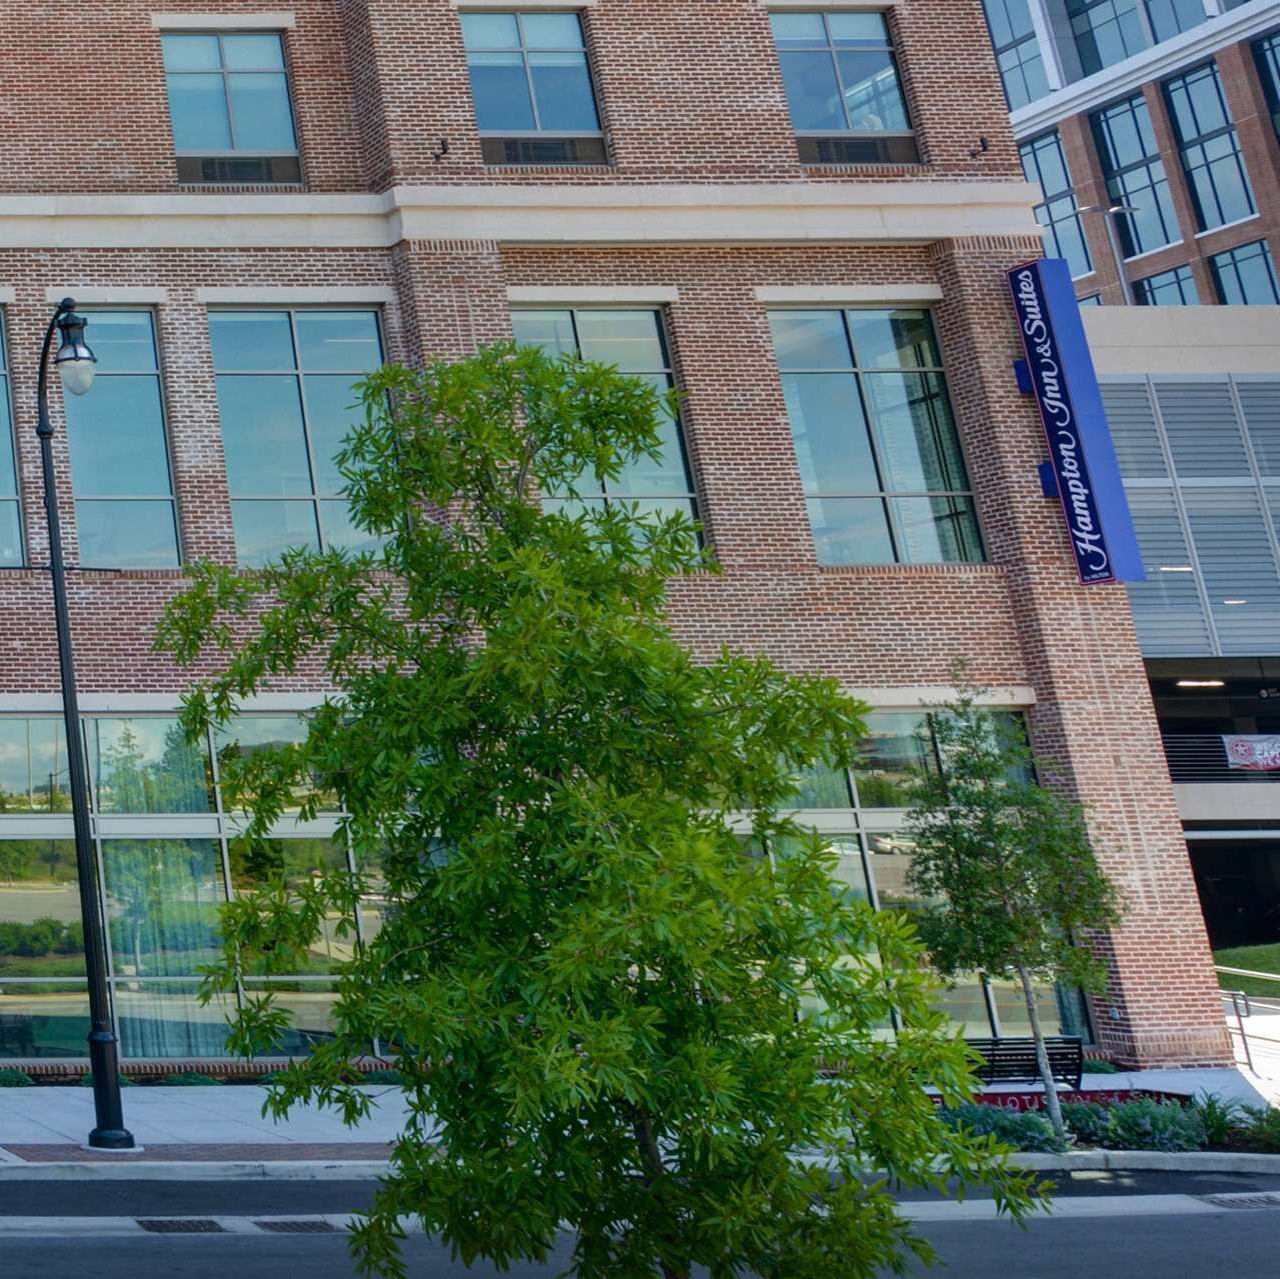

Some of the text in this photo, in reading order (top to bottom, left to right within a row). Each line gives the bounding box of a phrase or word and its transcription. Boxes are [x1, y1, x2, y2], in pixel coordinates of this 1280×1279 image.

[1017, 270, 1107, 571] Hampton Inn & Suites
